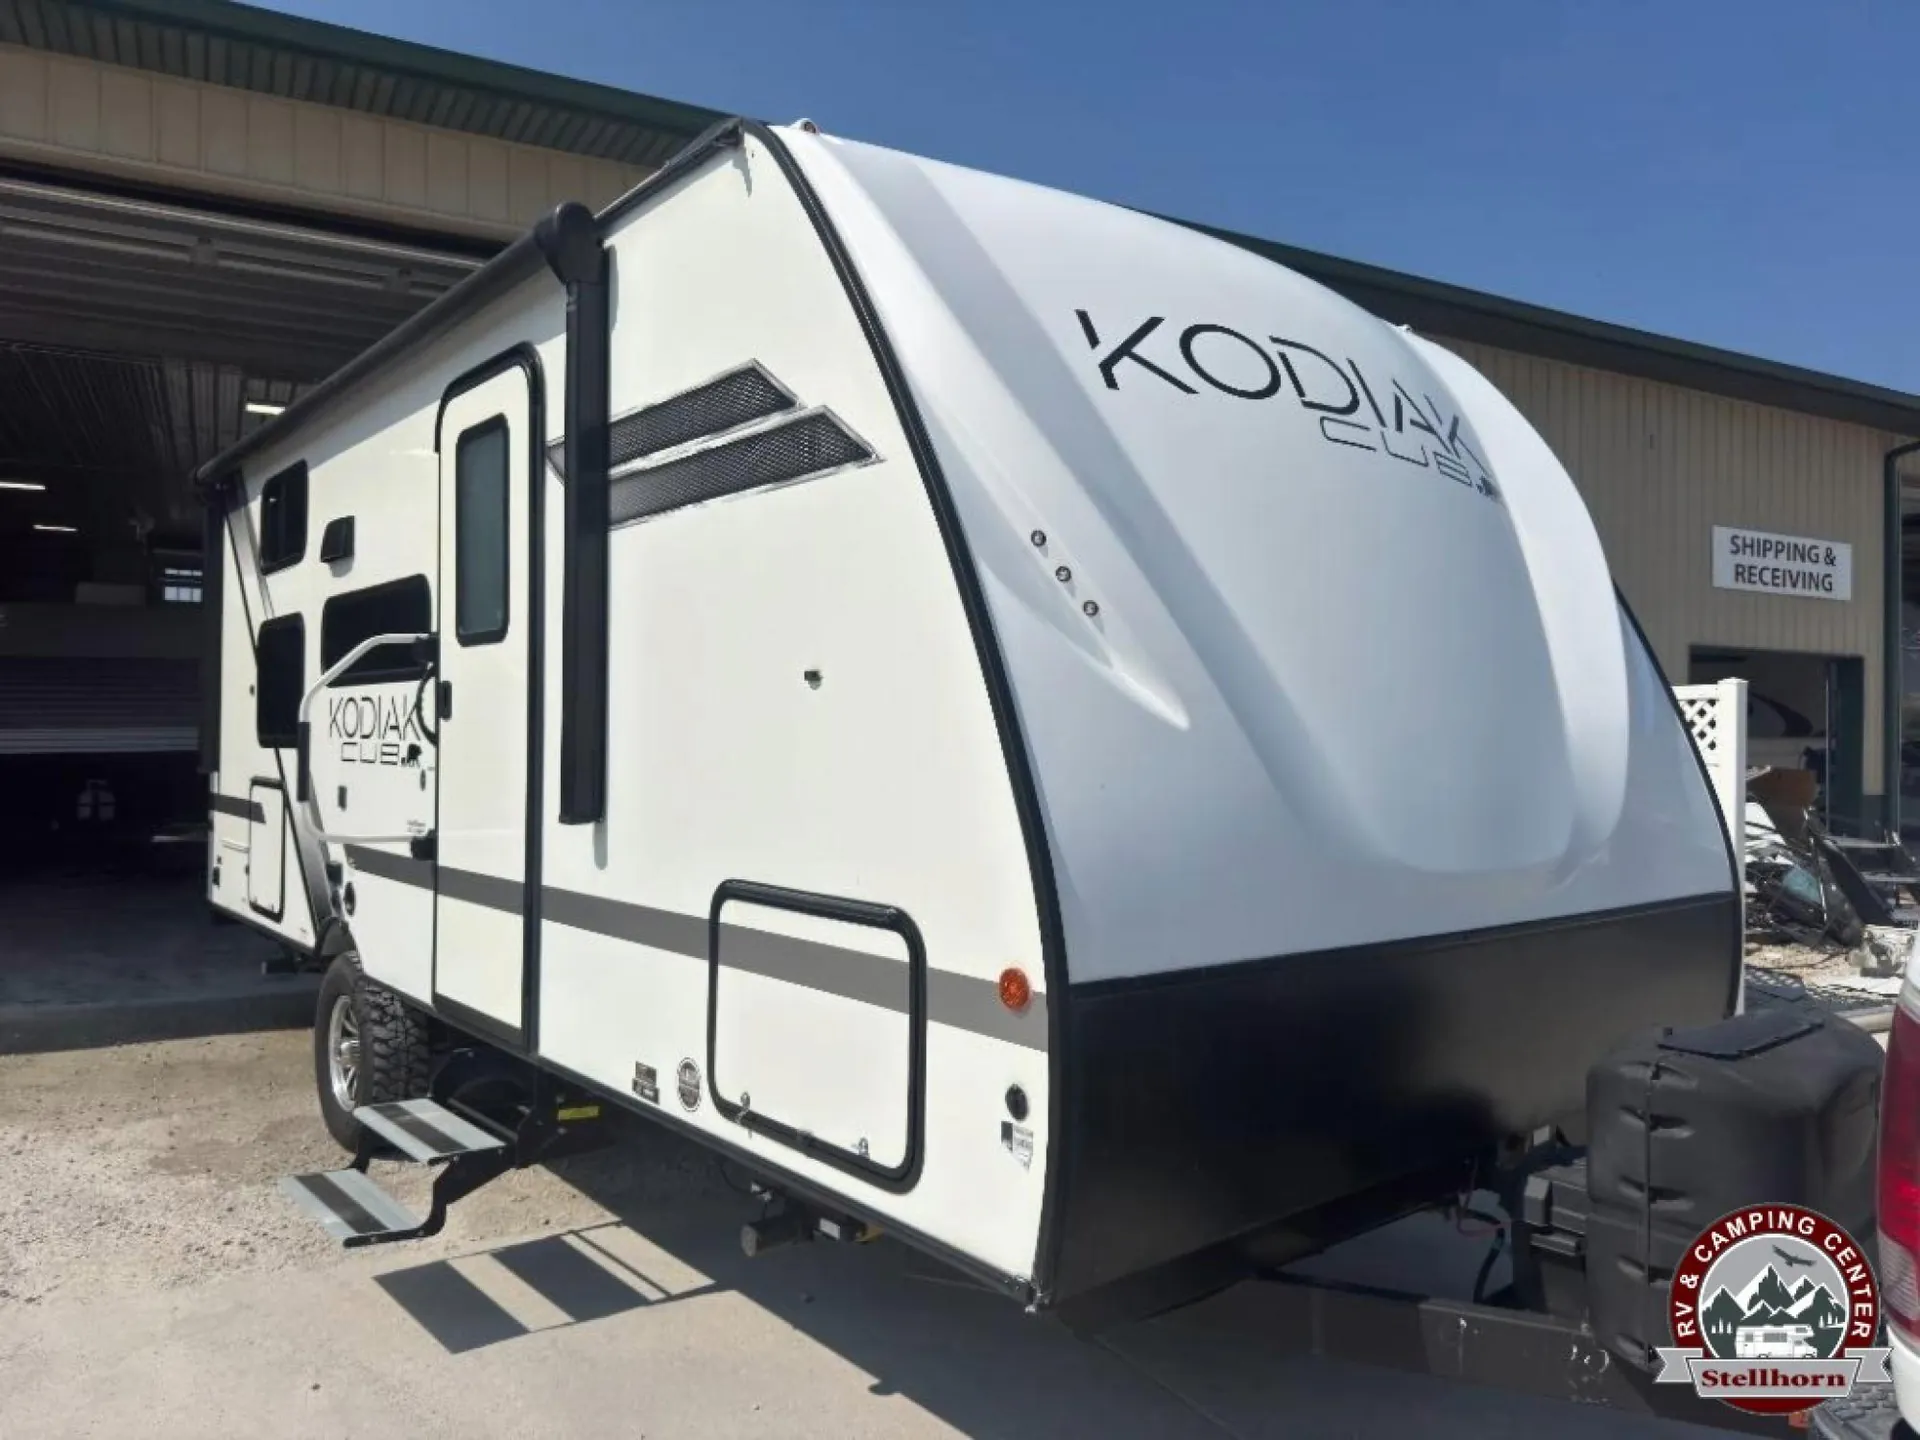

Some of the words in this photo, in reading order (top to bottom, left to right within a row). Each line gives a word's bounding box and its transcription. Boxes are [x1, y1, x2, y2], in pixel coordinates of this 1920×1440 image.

[1075, 309, 1491, 477] KODIAK
[1320, 416, 1473, 487] CUB
[1729, 534, 1820, 564] SHIPPING
[1823, 546, 1837, 567] &
[1734, 563, 1833, 593] RECEIVING
[329, 694, 421, 741] KODIAK
[340, 741, 400, 766] CUB
